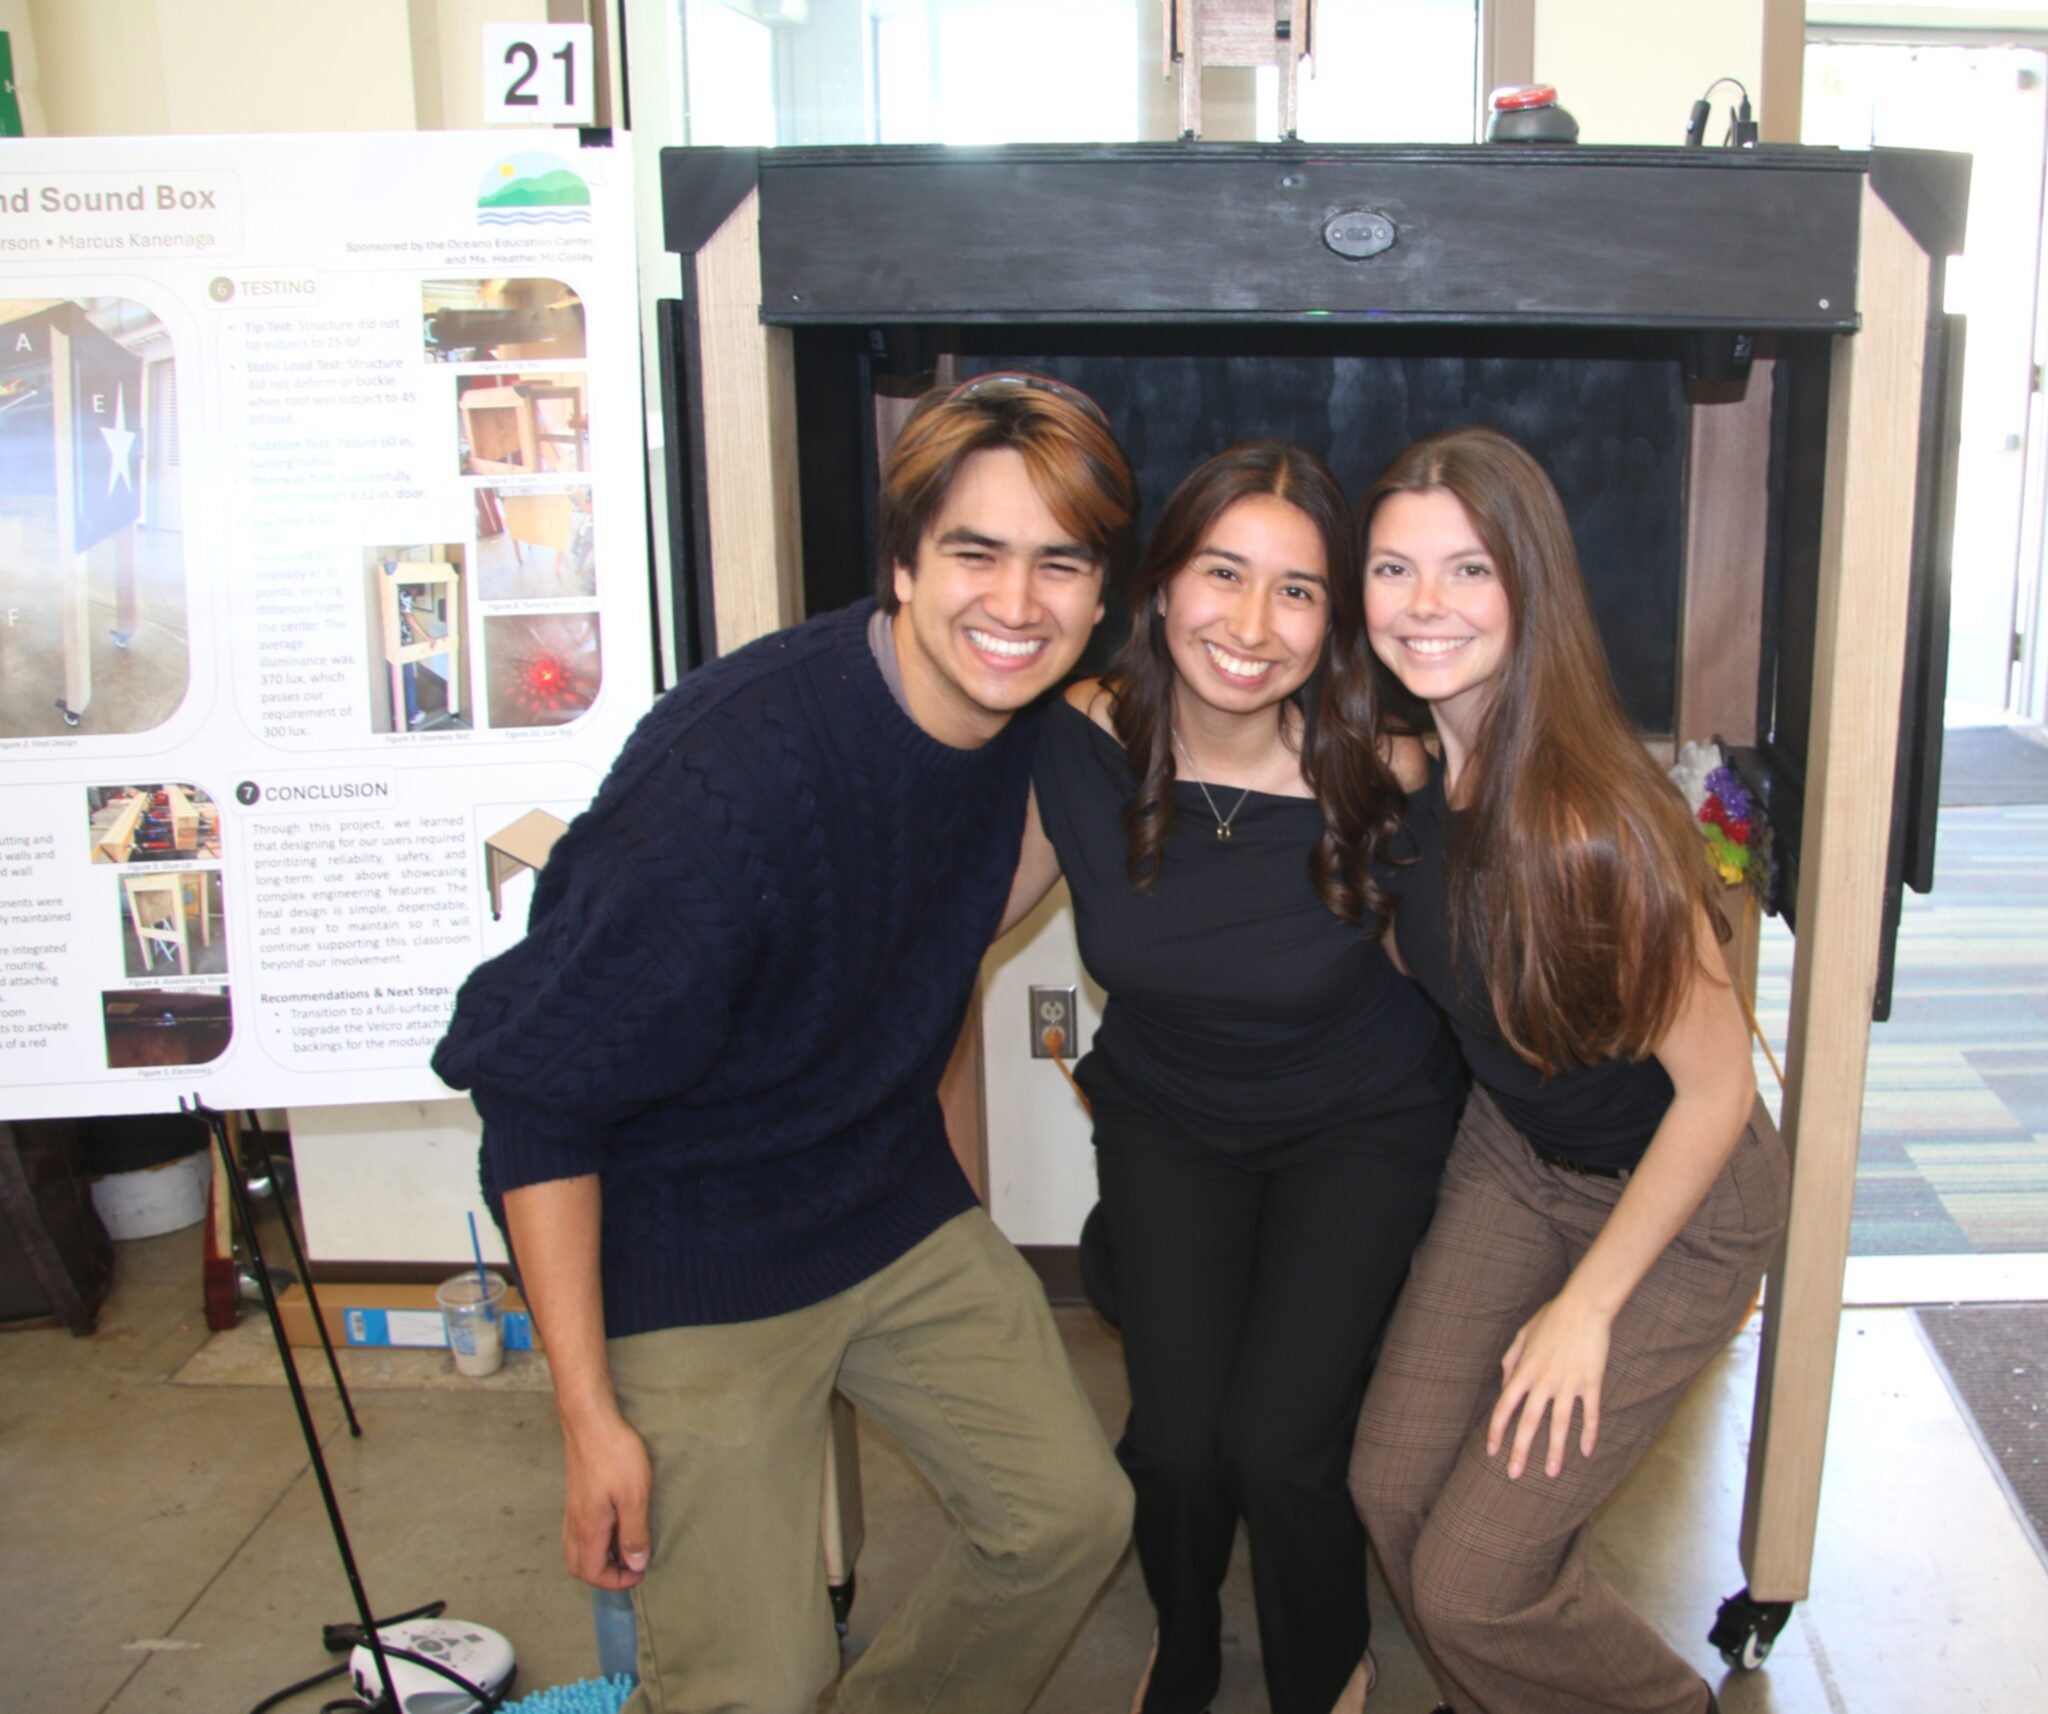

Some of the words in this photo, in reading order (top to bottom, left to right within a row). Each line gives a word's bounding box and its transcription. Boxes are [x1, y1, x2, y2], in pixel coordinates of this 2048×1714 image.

[503, 41, 578, 107] 21
[0, 188, 30, 213] nd
[40, 186, 144, 212] Sound
[156, 184, 216, 209] Box
[59, 234, 124, 249] Marcus
[129, 233, 216, 250] Kanenaga
[345, 242, 408, 252] Sponsored
[410, 241, 424, 252] by
[425, 240, 445, 250] the
[447, 239, 492, 249] Oceano
[494, 237, 553, 248] Education
[554, 236, 592, 246] Center
[444, 256, 467, 265] and
[470, 254, 489, 264] Ms.
[492, 254, 538, 263] Heather
[241, 280, 316, 295] TESTING
[245, 322, 265, 334] Tip
[266, 321, 295, 332] Test:
[298, 319, 354, 331] Structure
[357, 319, 376, 330] did
[380, 319, 400, 329] not
[15, 333, 32, 351] A
[247, 362, 281, 373] Static
[282, 360, 314, 372] Load
[316, 359, 345, 370] Test:
[347, 358, 403, 369] Structure
[248, 379, 266, 390] did
[269, 378, 290, 390] not
[293, 376, 338, 389] deform
[338, 375, 354, 388] or
[356, 375, 395, 386] buckle
[93, 395, 105, 413] E
[249, 397, 282, 407] when
[284, 395, 310, 406] roof
[313, 396, 336, 405] was
[337, 391, 382, 406] subject
[385, 393, 398, 403] to
[401, 392, 416, 402] 45
[257, 604, 313, 615] distances
[315, 602, 343, 612] from
[7, 608, 20, 627] F
[258, 621, 276, 633] the
[279, 621, 318, 631] center.
[326, 617, 346, 629] The
[258, 640, 304, 652] average
[259, 656, 327, 667] illuminance
[330, 656, 354, 664] was
[260, 674, 284, 685] 370
[286, 673, 307, 684] lux,
[309, 671, 345, 683] which
[261, 693, 301, 703] passes
[303, 692, 324, 701] our
[262, 708, 336, 720] requirement
[339, 706, 352, 717] of
[264, 726, 286, 738] 300
[288, 726, 308, 736] lux.
[243, 787, 253, 800] 7
[265, 784, 388, 800] CONCLUSION
[252, 823, 302, 836] Through
[309, 822, 332, 832] this
[339, 820, 385, 832] project,
[393, 820, 411, 828] we
[419, 816, 464, 826] learned
[32, 834, 54, 844] and
[254, 841, 277, 851] that
[280, 839, 336, 852] designing
[338, 837, 355, 848] for
[358, 838, 379, 847] our
[382, 837, 413, 845] users
[416, 833, 465, 845] required
[4, 851, 32, 861] walls
[34, 850, 55, 859] and
[255, 858, 318, 870] prioritizing
[328, 854, 385, 865] reliability,
[395, 851, 434, 863] safety,
[442, 850, 466, 860] and
[10, 866, 32, 876] wall
[255, 874, 315, 887] long-term
[323, 874, 344, 882] use
[354, 870, 391, 880] above
[400, 867, 466, 879] showcasing
[256, 892, 306, 903] complex
[311, 890, 382, 901] engineering
[387, 885, 439, 895] features.
[445, 882, 468, 893] The
[257, 908, 283, 918] final
[289, 907, 328, 919] design
[333, 906, 343, 916] is
[348, 904, 391, 915] simple,
[397, 900, 469, 912] dependable,
[11, 913, 72, 923] maintained
[259, 925, 281, 936] and
[288, 926, 317, 936] easy
[325, 923, 339, 933] to
[348, 922, 400, 931] maintain
[408, 920, 423, 929] so
[432, 916, 440, 928] it
[449, 916, 470, 926] will
[12, 944, 67, 956] integrated
[260, 943, 311, 952] continue
[316, 940, 380, 951] supporting
[385, 937, 407, 947] this
[412, 935, 471, 945] classroom
[5, 961, 47, 973] routing,
[261, 958, 304, 970] beyond
[307, 959, 327, 968] our
[330, 955, 403, 965] involvement.
[9, 975, 58, 988] attaching
[260, 991, 370, 1002] Recommendations
[374, 988, 383, 998] &
[386, 987, 414, 997] Next
[290, 1007, 347, 1019] Transition
[350, 1007, 364, 1016] to
[366, 1007, 373, 1015] a
[375, 1001, 441, 1014] full-surface
[12, 1024, 24, 1033] to
[27, 1022, 69, 1032] activate
[292, 1025, 341, 1037] Upgrade
[344, 1023, 364, 1033] the
[366, 1021, 403, 1031] Velcro
[6, 1039, 16, 1049] of
[19, 1040, 26, 1048] a
[28, 1038, 47, 1048] red
[293, 1041, 343, 1054] backings
[345, 1039, 362, 1050] for
[365, 1039, 385, 1048] the
